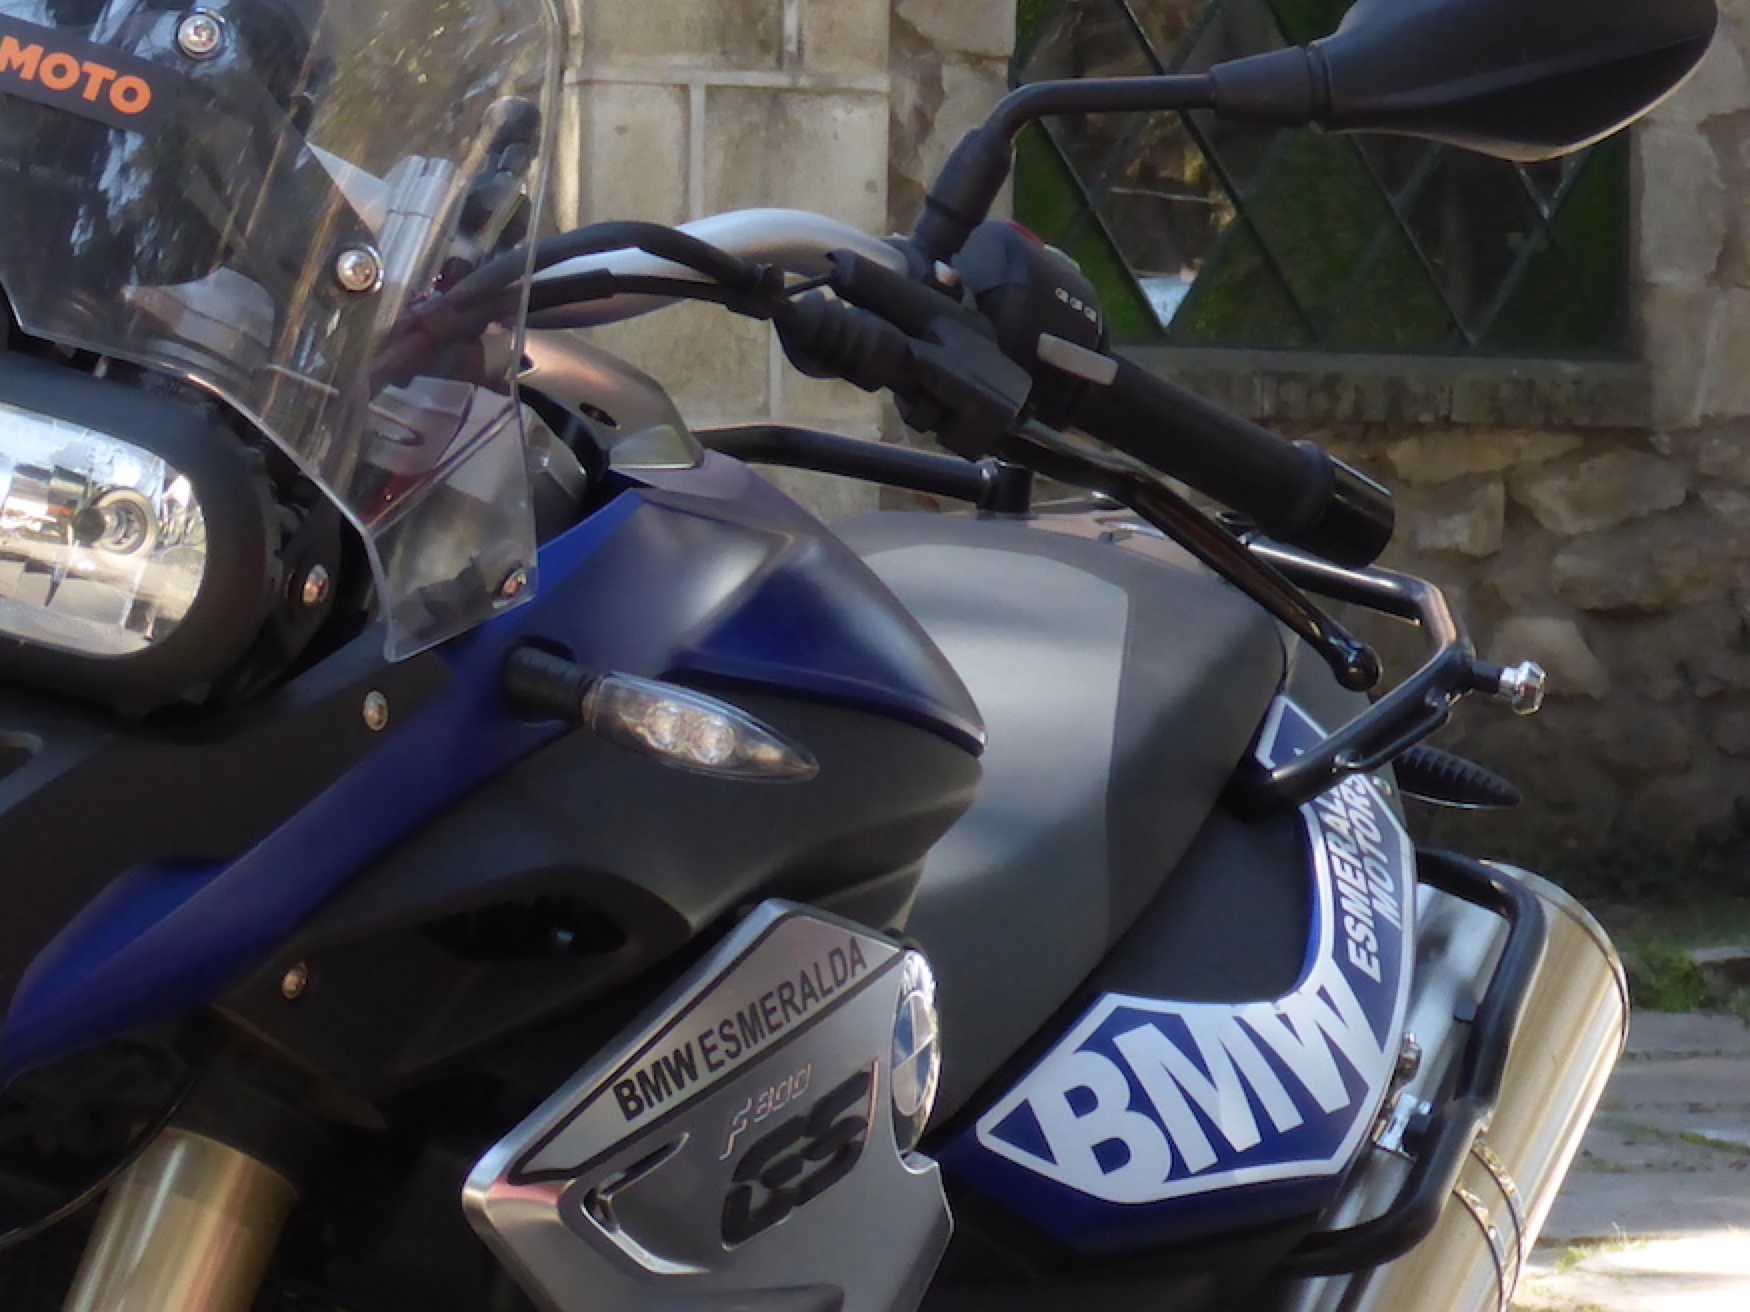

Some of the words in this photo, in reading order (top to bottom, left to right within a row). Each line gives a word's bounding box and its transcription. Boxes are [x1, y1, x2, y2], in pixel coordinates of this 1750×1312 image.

[1314, 782, 1382, 983] ESMERAL
[613, 1042, 699, 1122] BMW
[697, 936, 868, 1073] ESMERALDA
[1030, 984, 1366, 1188] BMW
